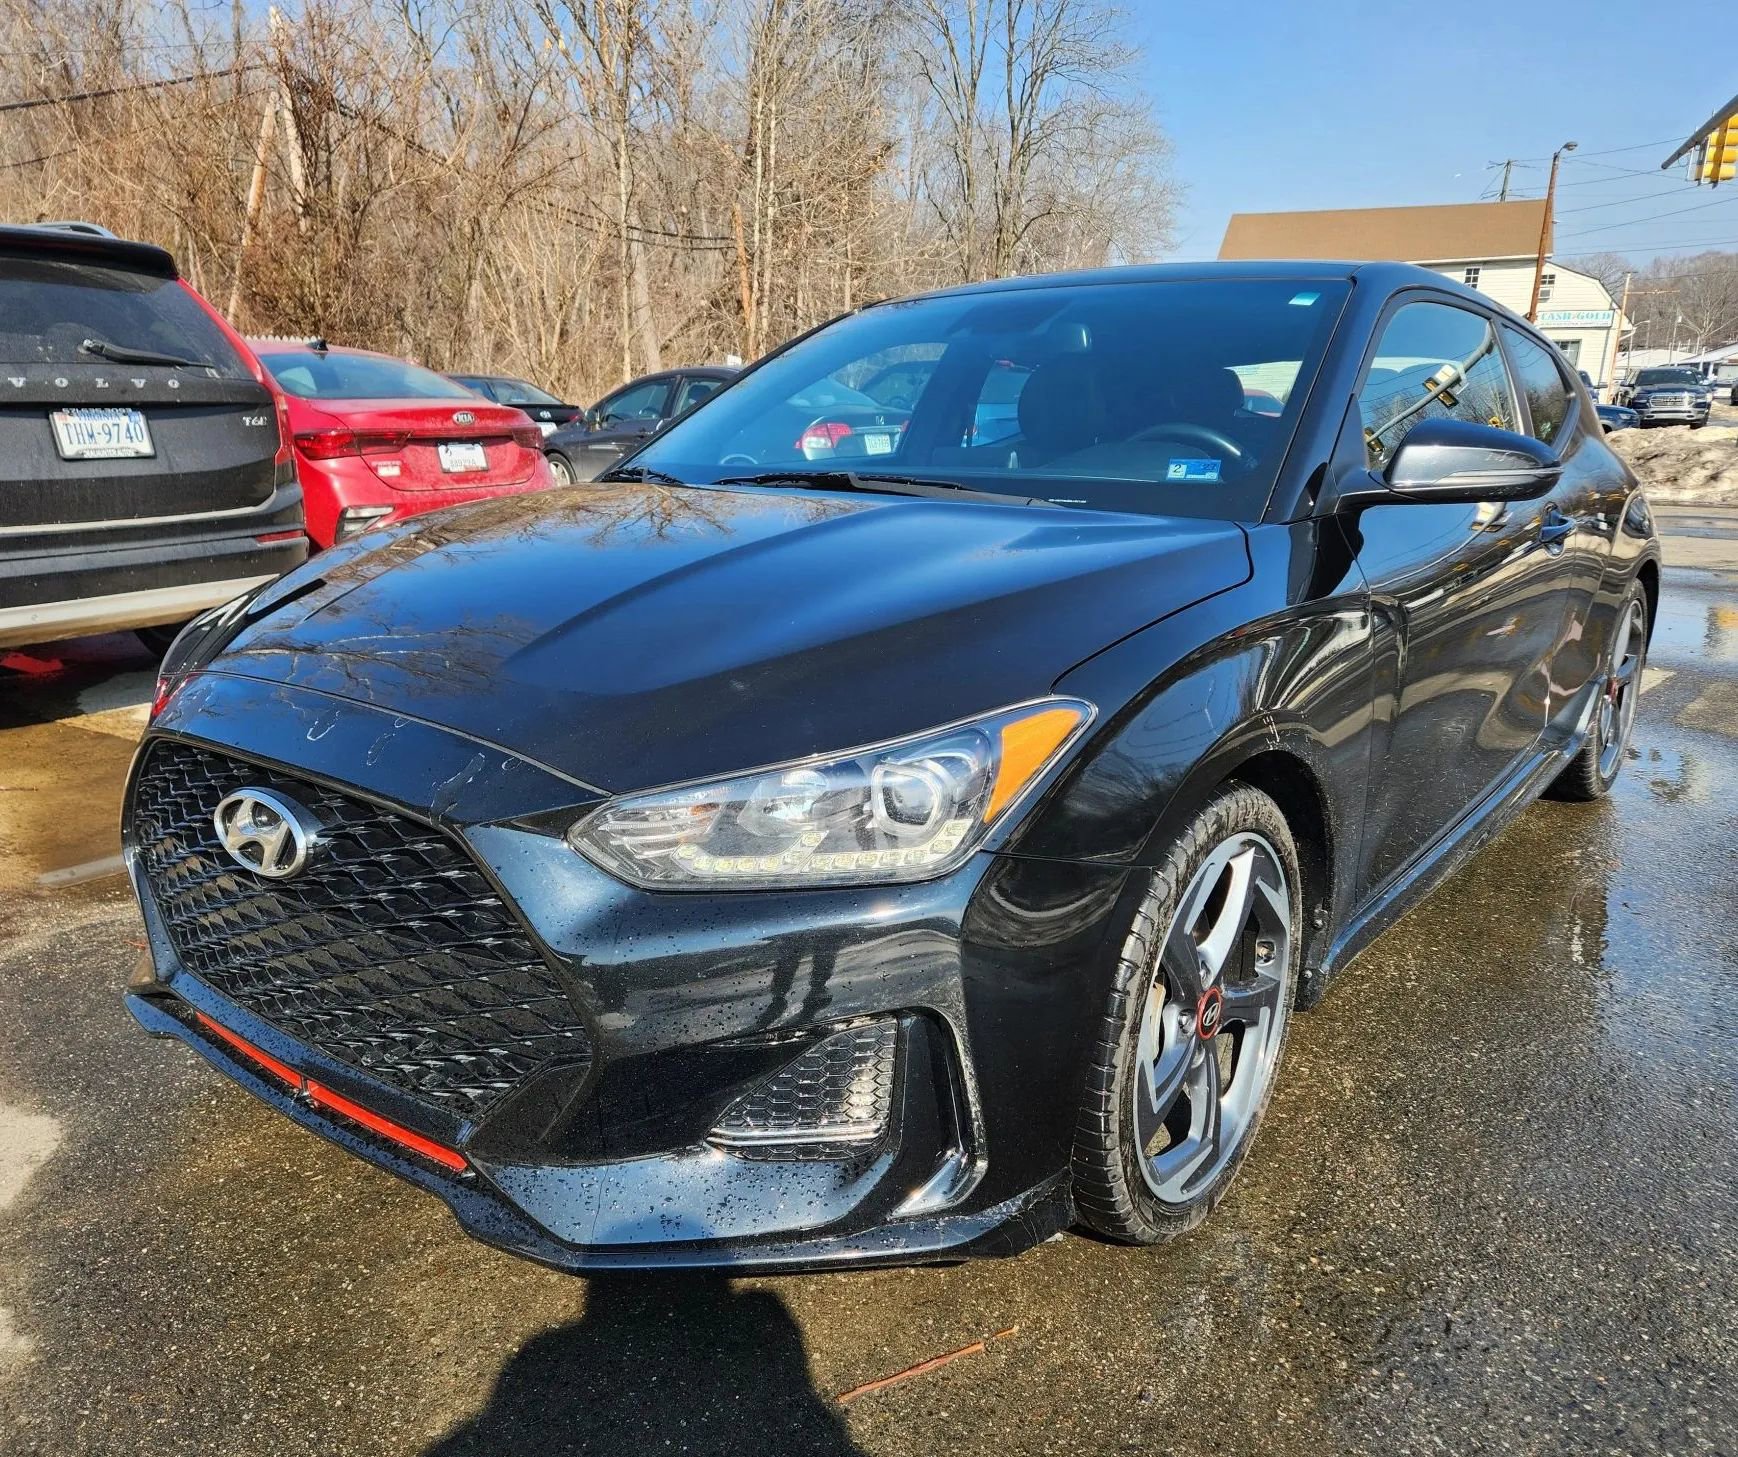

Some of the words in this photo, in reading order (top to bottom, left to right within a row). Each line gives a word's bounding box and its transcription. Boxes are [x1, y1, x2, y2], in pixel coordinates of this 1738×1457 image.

[1576, 312, 1611, 320] GOLD
[7, 377, 181, 389] VOLVO
[1173, 463, 1182, 473] 2
